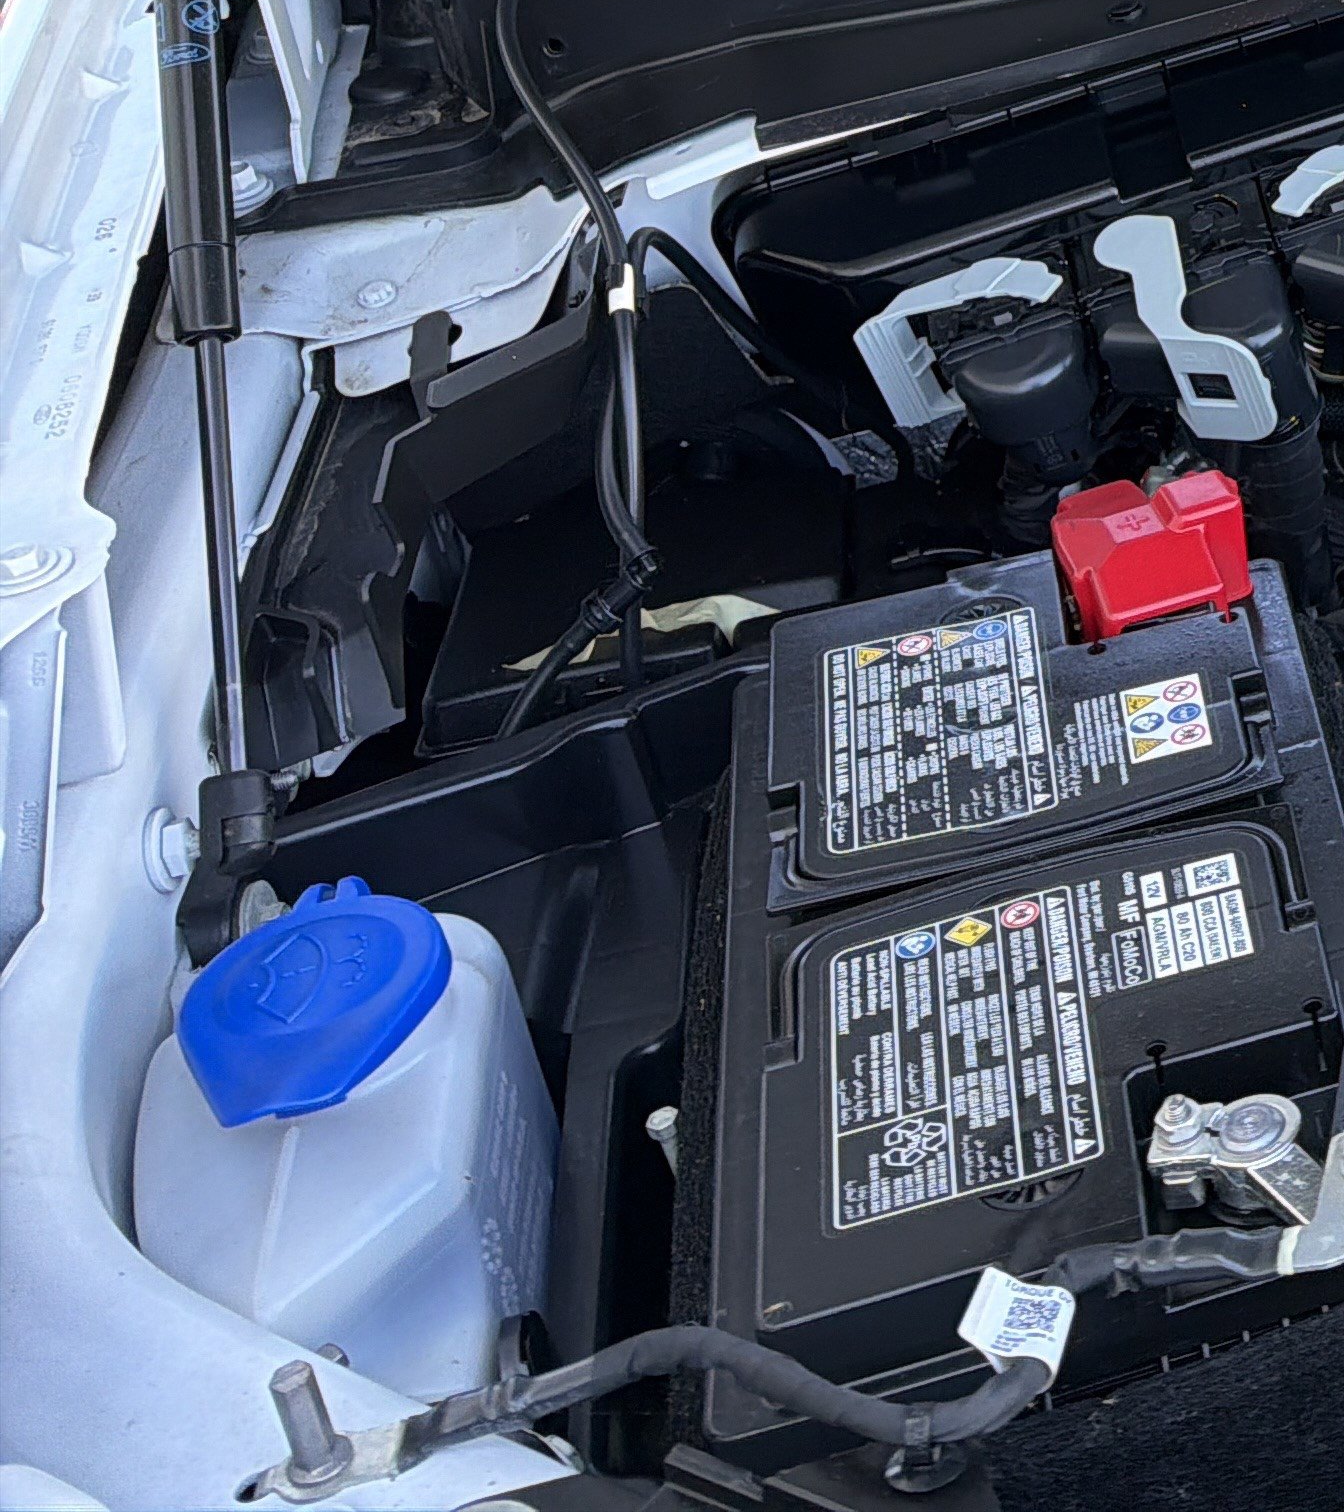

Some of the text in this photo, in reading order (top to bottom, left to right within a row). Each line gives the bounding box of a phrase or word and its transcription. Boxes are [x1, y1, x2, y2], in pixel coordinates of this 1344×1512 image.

[1144, 879, 1162, 899] 12V
[1116, 898, 1141, 925] MF
[1175, 910, 1190, 925] 80
[1177, 925, 1194, 941] Ah
[1202, 915, 1218, 933] CCA
[1150, 915, 1173, 972] AGM/VRLA
[1180, 940, 1197, 962] C20
[1116, 929, 1146, 986] FoMoCo
